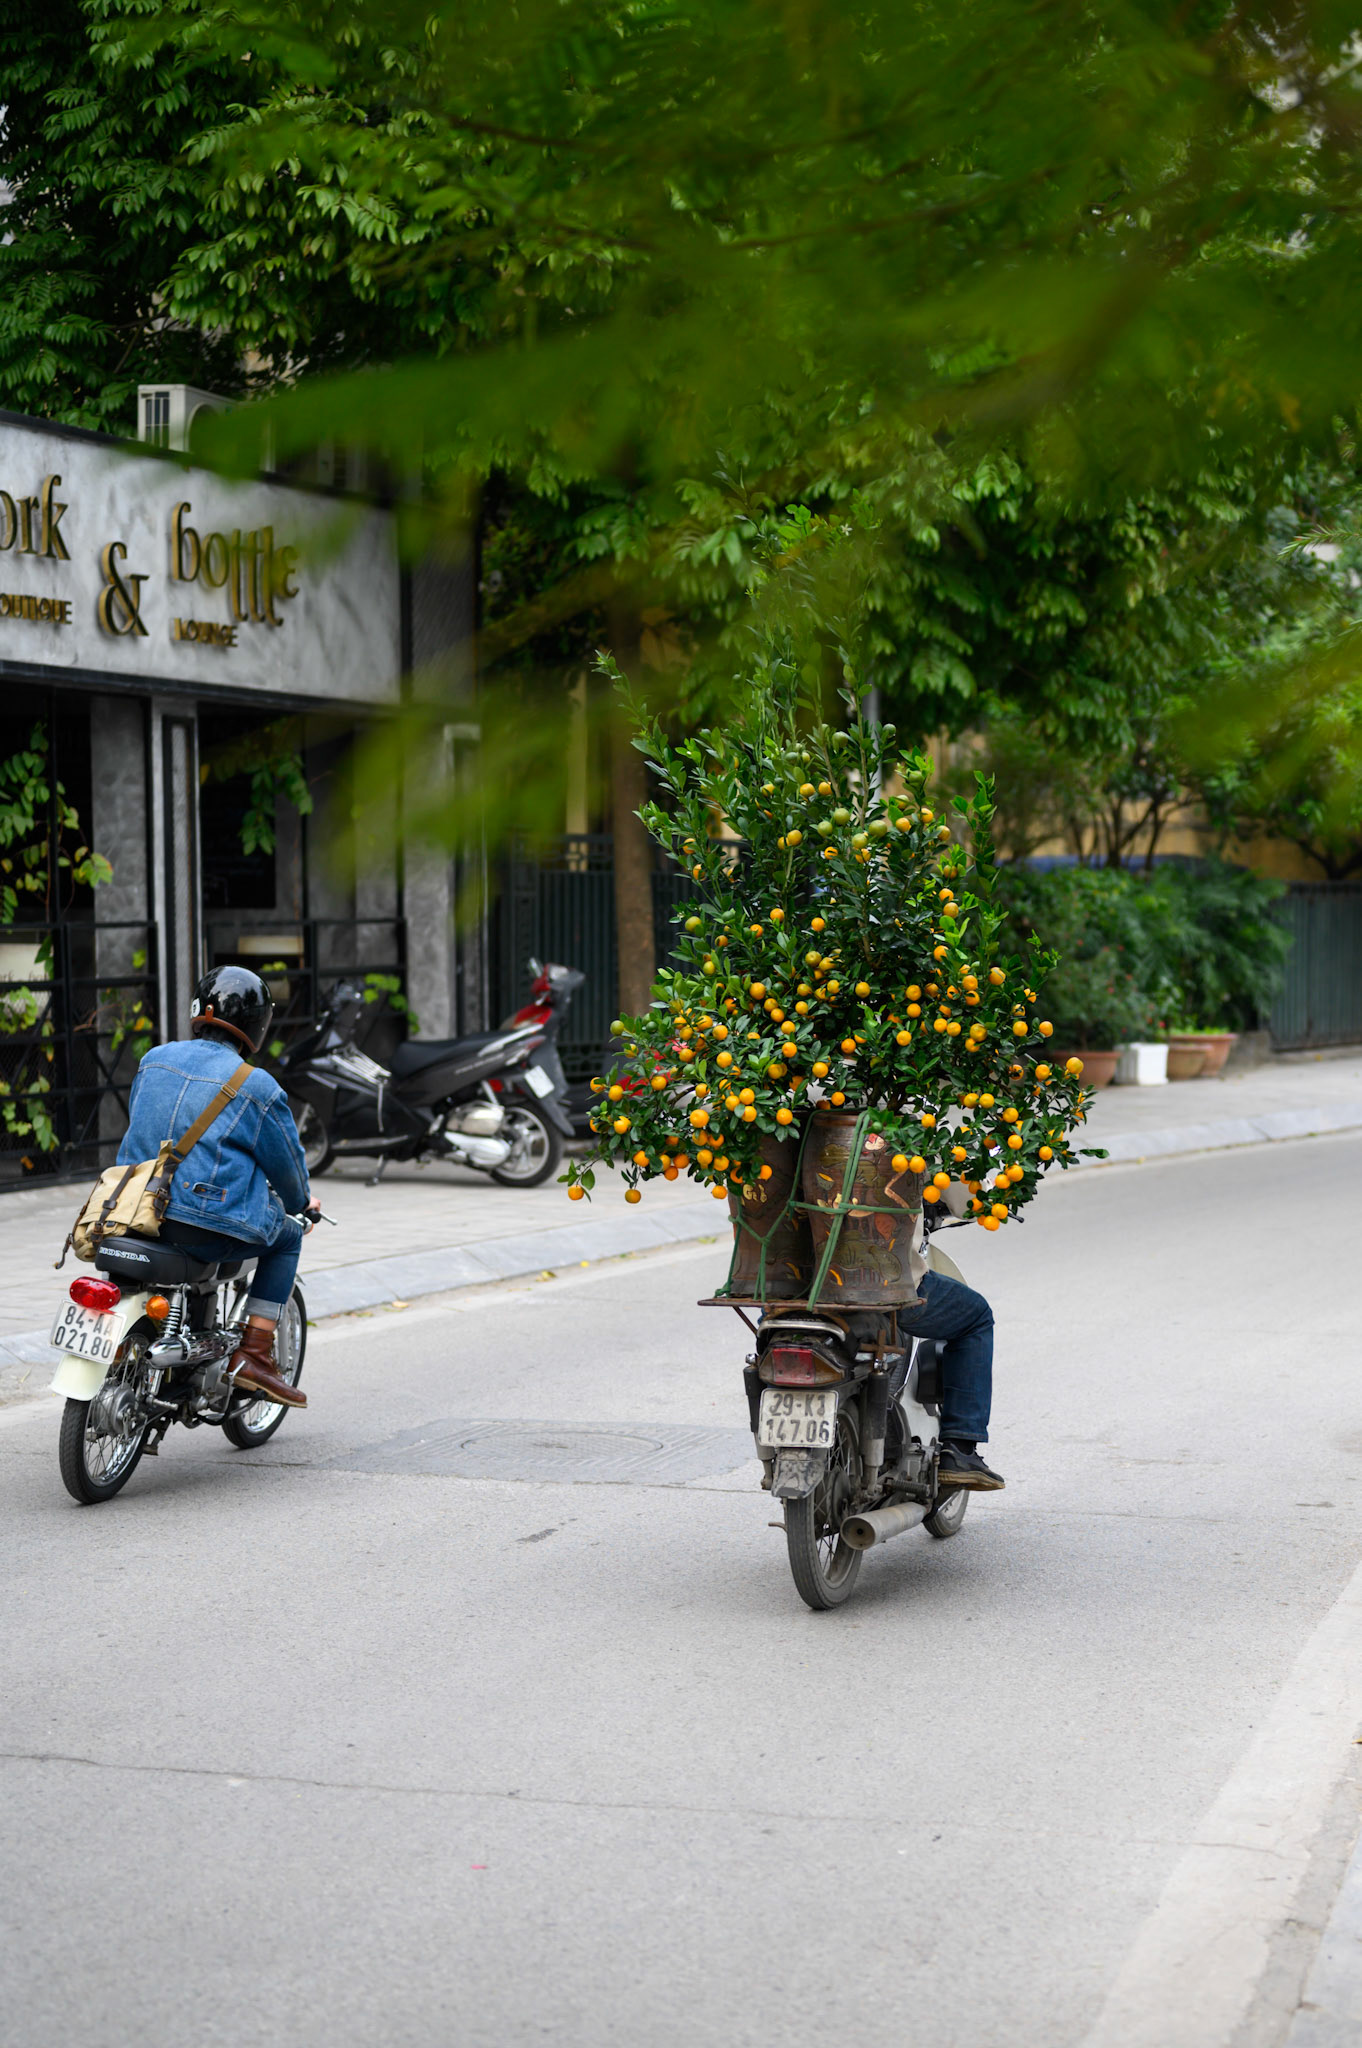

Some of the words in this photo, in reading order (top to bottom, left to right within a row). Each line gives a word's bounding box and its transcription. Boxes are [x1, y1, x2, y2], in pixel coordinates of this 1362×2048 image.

[99, 541, 150, 637] &
[171, 501, 300, 627] bottle
[173, 617, 238, 648] LOUNGE
[99, 1246, 150, 1263] HONDA
[54, 1326, 113, 1359] 021.80
[766, 1418, 830, 1444] 147.06
